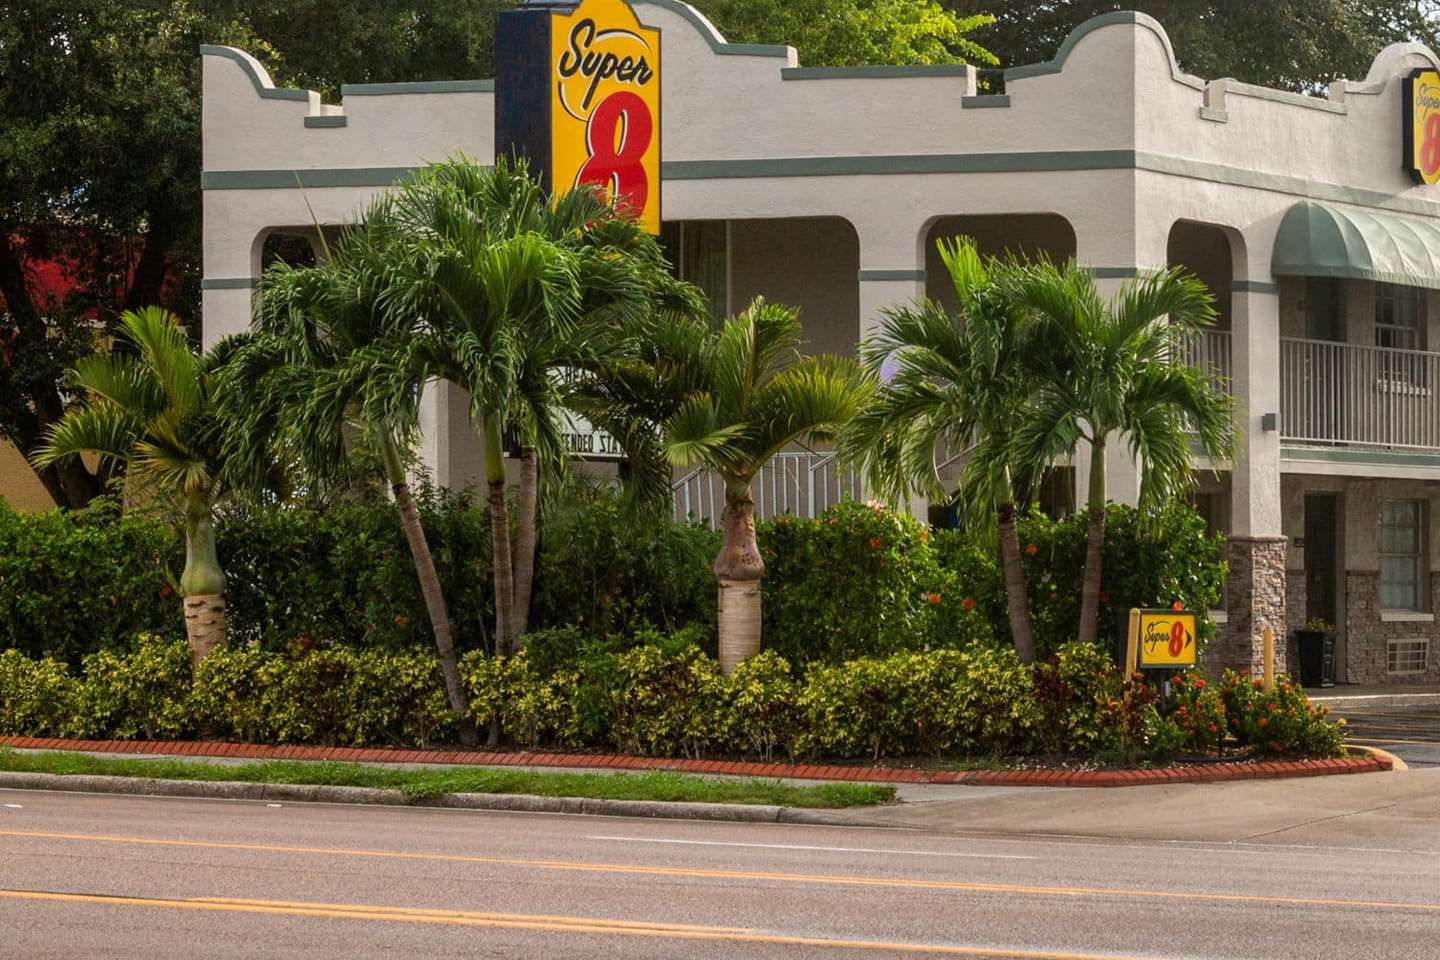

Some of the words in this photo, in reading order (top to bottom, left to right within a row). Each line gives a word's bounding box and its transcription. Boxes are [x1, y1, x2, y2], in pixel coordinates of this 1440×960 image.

[558, 18, 654, 110] Super
[574, 90, 653, 231] 8
[1144, 621, 1170, 653] Super
[1168, 621, 1184, 658] 8
